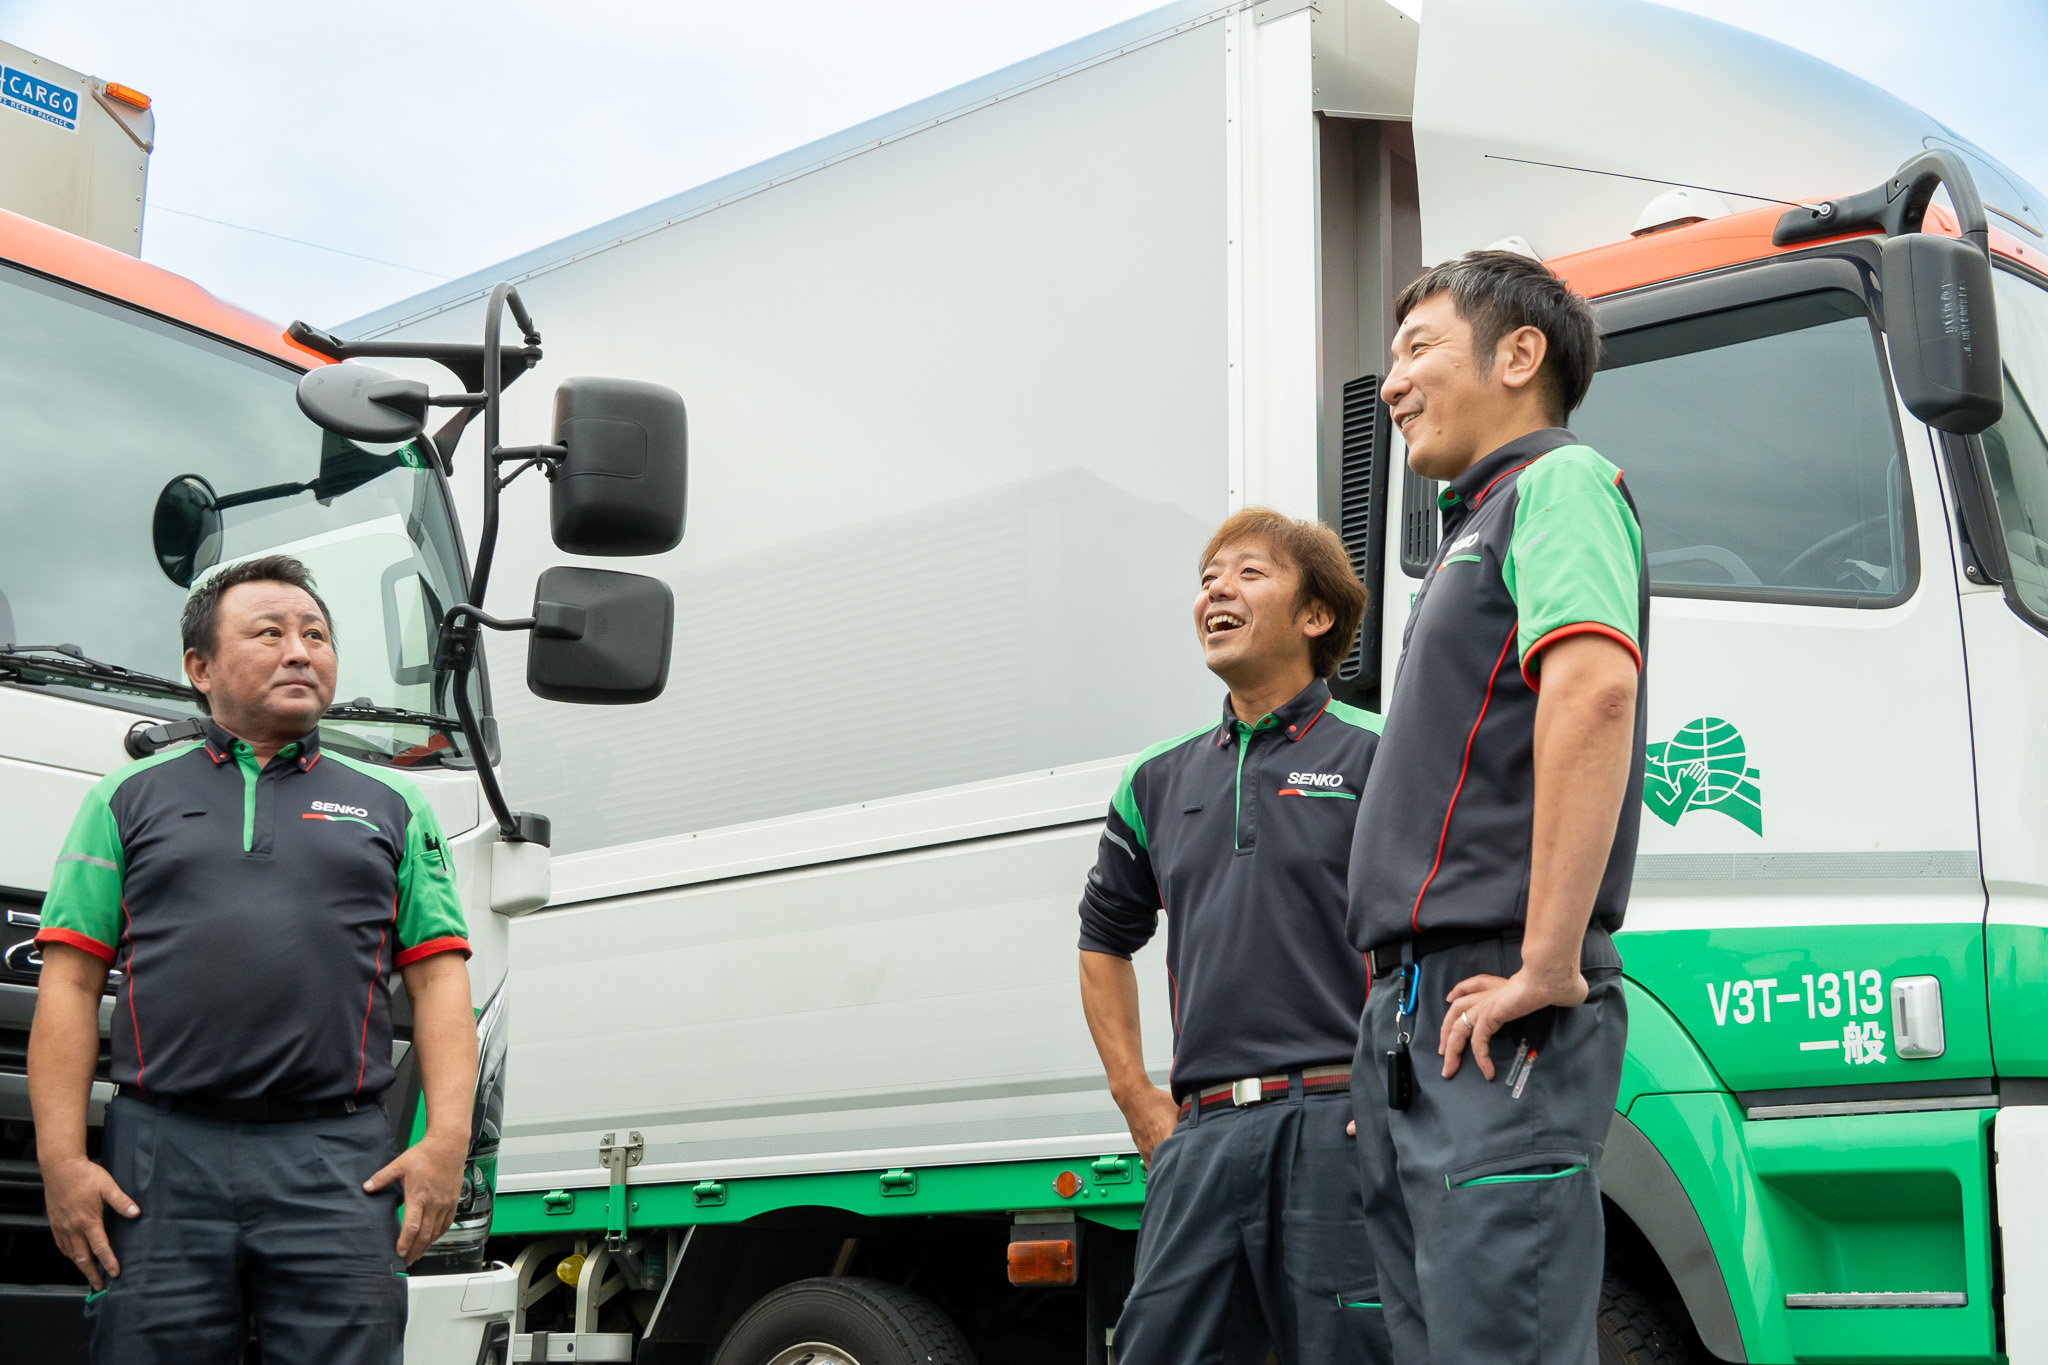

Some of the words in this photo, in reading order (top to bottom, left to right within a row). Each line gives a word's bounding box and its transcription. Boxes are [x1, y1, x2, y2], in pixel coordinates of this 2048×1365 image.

[9, 76, 73, 113] CARGO
[37, 111, 69, 128] PACKAGE
[1287, 771, 1344, 787] SENKO
[311, 801, 368, 817] SENKO
[1706, 969, 1884, 1027] V3T-1313
[1799, 1020, 1888, 1065] 一般
